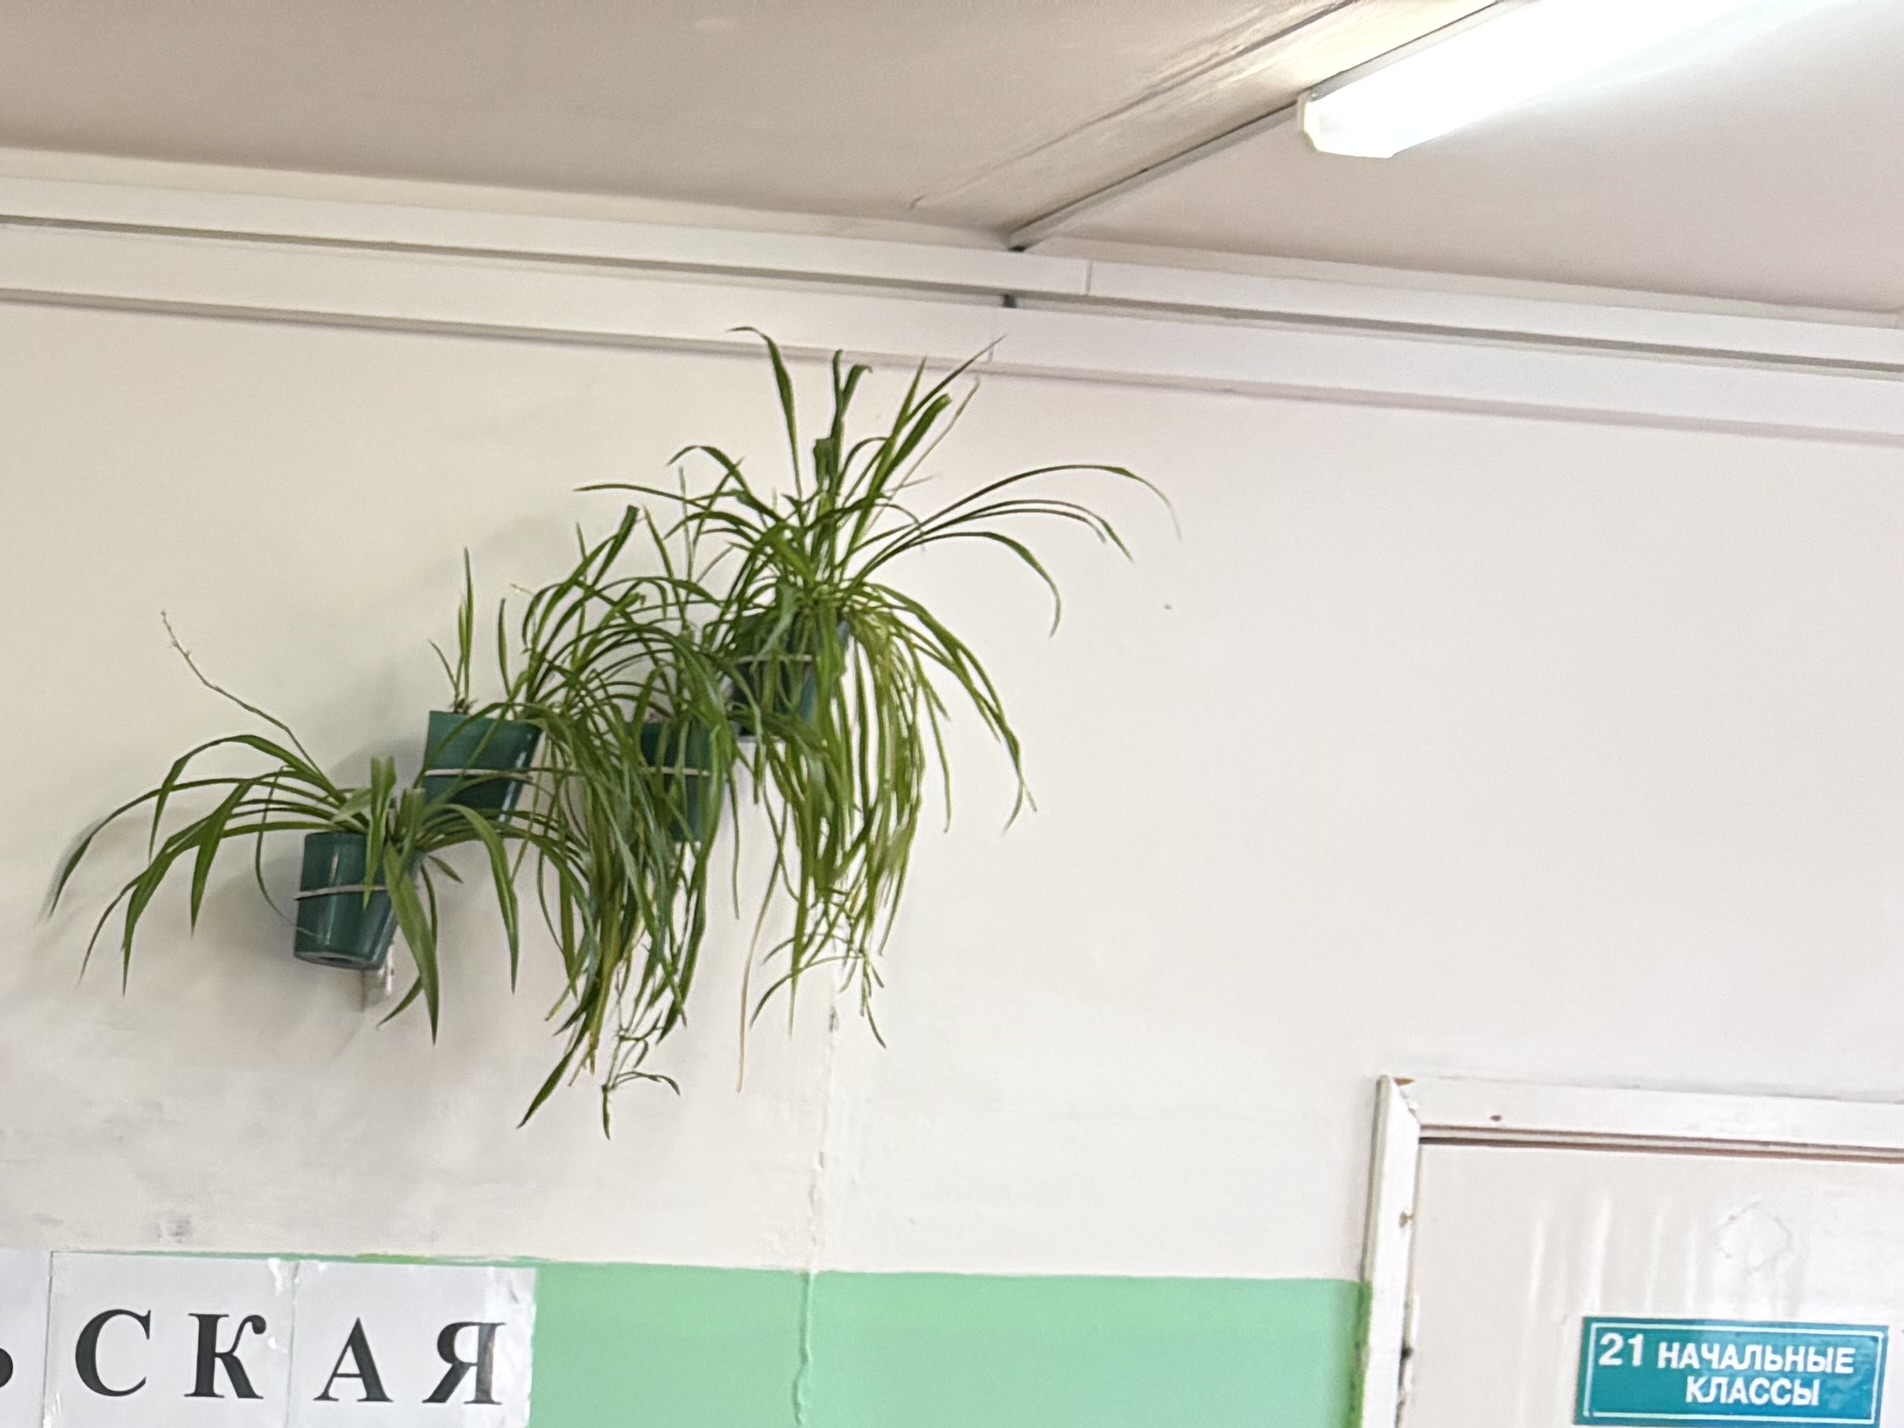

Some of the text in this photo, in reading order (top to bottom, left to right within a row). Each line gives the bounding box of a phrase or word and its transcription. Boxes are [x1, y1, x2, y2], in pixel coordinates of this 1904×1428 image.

[1598, 1332, 1857, 1375] 21 НАЧАЛЬНЫЕ
[1685, 1375, 1820, 1407] КЛАССЫ
